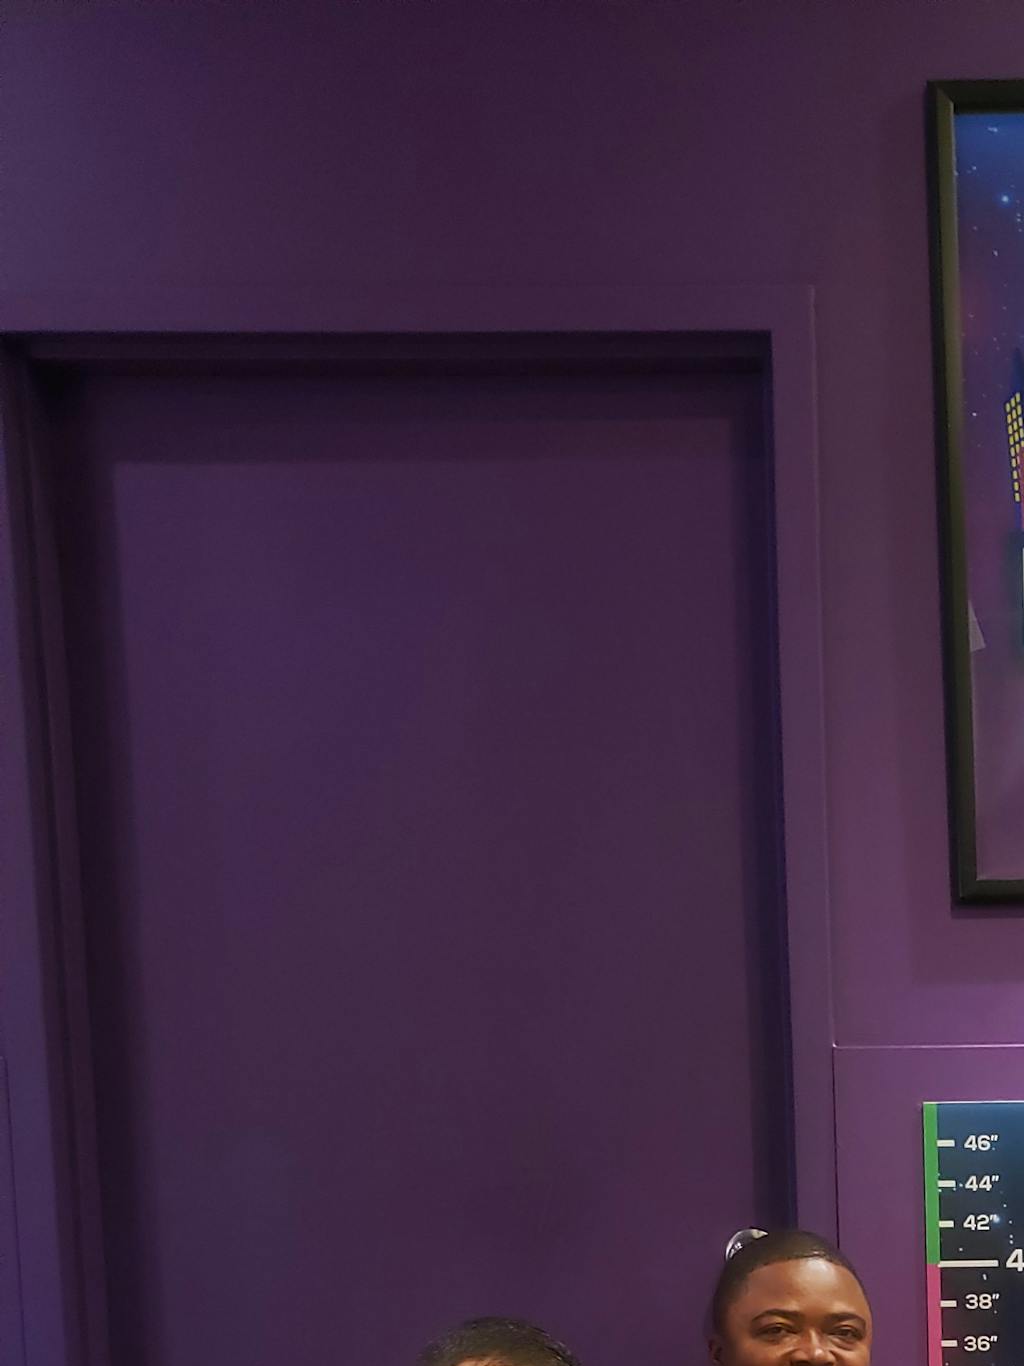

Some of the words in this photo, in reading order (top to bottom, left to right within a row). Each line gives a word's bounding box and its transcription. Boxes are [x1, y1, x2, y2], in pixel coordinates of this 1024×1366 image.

[963, 1134, 999, 1151] 46"
[964, 1175, 1000, 1192] 44"
[964, 1293, 1000, 1310] 38"
[963, 1335, 998, 1352] 36"
